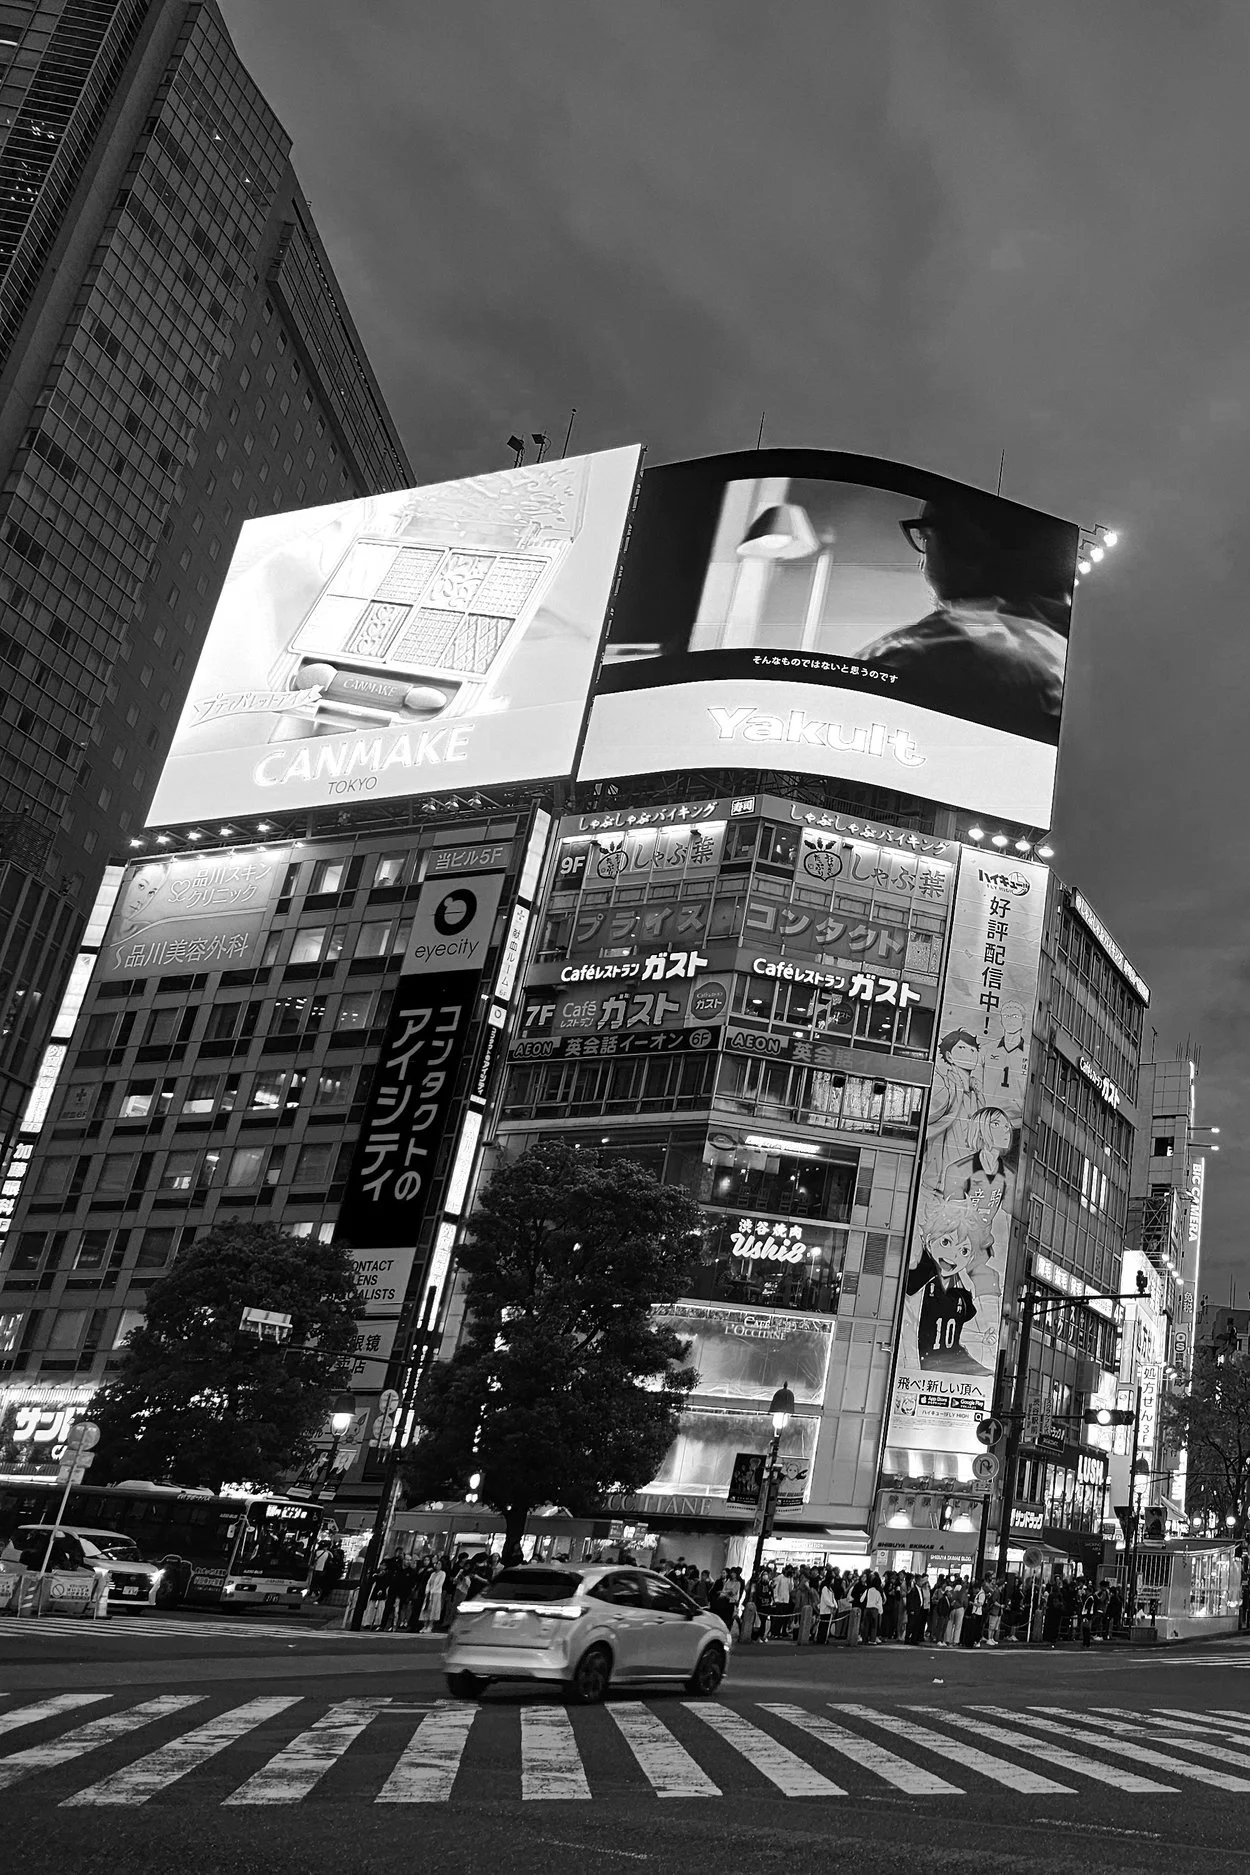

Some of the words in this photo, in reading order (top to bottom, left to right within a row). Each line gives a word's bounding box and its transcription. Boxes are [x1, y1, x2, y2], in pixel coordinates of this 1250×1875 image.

[342, 678, 398, 698] CANMAKE
[707, 706, 927, 767] Yakult
[253, 723, 476, 786] CANMAKE
[327, 776, 378, 795] TOKYO
[579, 801, 718, 831] しゃぶしゃぶバイキング
[789, 804, 950, 856] しゃぶしゃぶバイキング
[435, 847, 505, 871] 当ビル5F
[560, 856, 586, 875] 9F
[633, 835, 715, 869] しゃぶ葉
[191, 861, 274, 889] 品川スキン
[851, 853, 946, 898] しゃぶ葉
[186, 882, 258, 909] クリニック
[577, 901, 706, 943] プライス
[746, 902, 906, 962] コンタクト
[126, 932, 250, 968] 品川美容外科
[414, 936, 480, 962] eyecity
[641, 951, 709, 981] ガスト
[979, 895, 1011, 1035] 好評配信中!
[848, 973, 921, 1008] ガスト
[525, 1004, 556, 1027] 7F
[562, 1000, 597, 1018] Café
[596, 992, 680, 1031] ガスト
[514, 1041, 554, 1059] AEON
[564, 1031, 684, 1056] 英会話イーオン
[690, 1030, 710, 1048] 6F
[732, 1032, 782, 1055] AEON
[360, 1008, 433, 1201] アイシティ
[393, 1005, 462, 1201] コンタクトの
[1192, 1163, 1202, 1185] BIC
[738, 1218, 803, 1240] 渋谷焼肉
[1188, 1189, 1201, 1242] CAMERA
[730, 1232, 807, 1264] Ushi8
[352, 1259, 395, 1273] ONTACT
[356, 1274, 379, 1286] ENS
[933, 1317, 956, 1350] 10
[1077, 1454, 1105, 1485] LUSH
